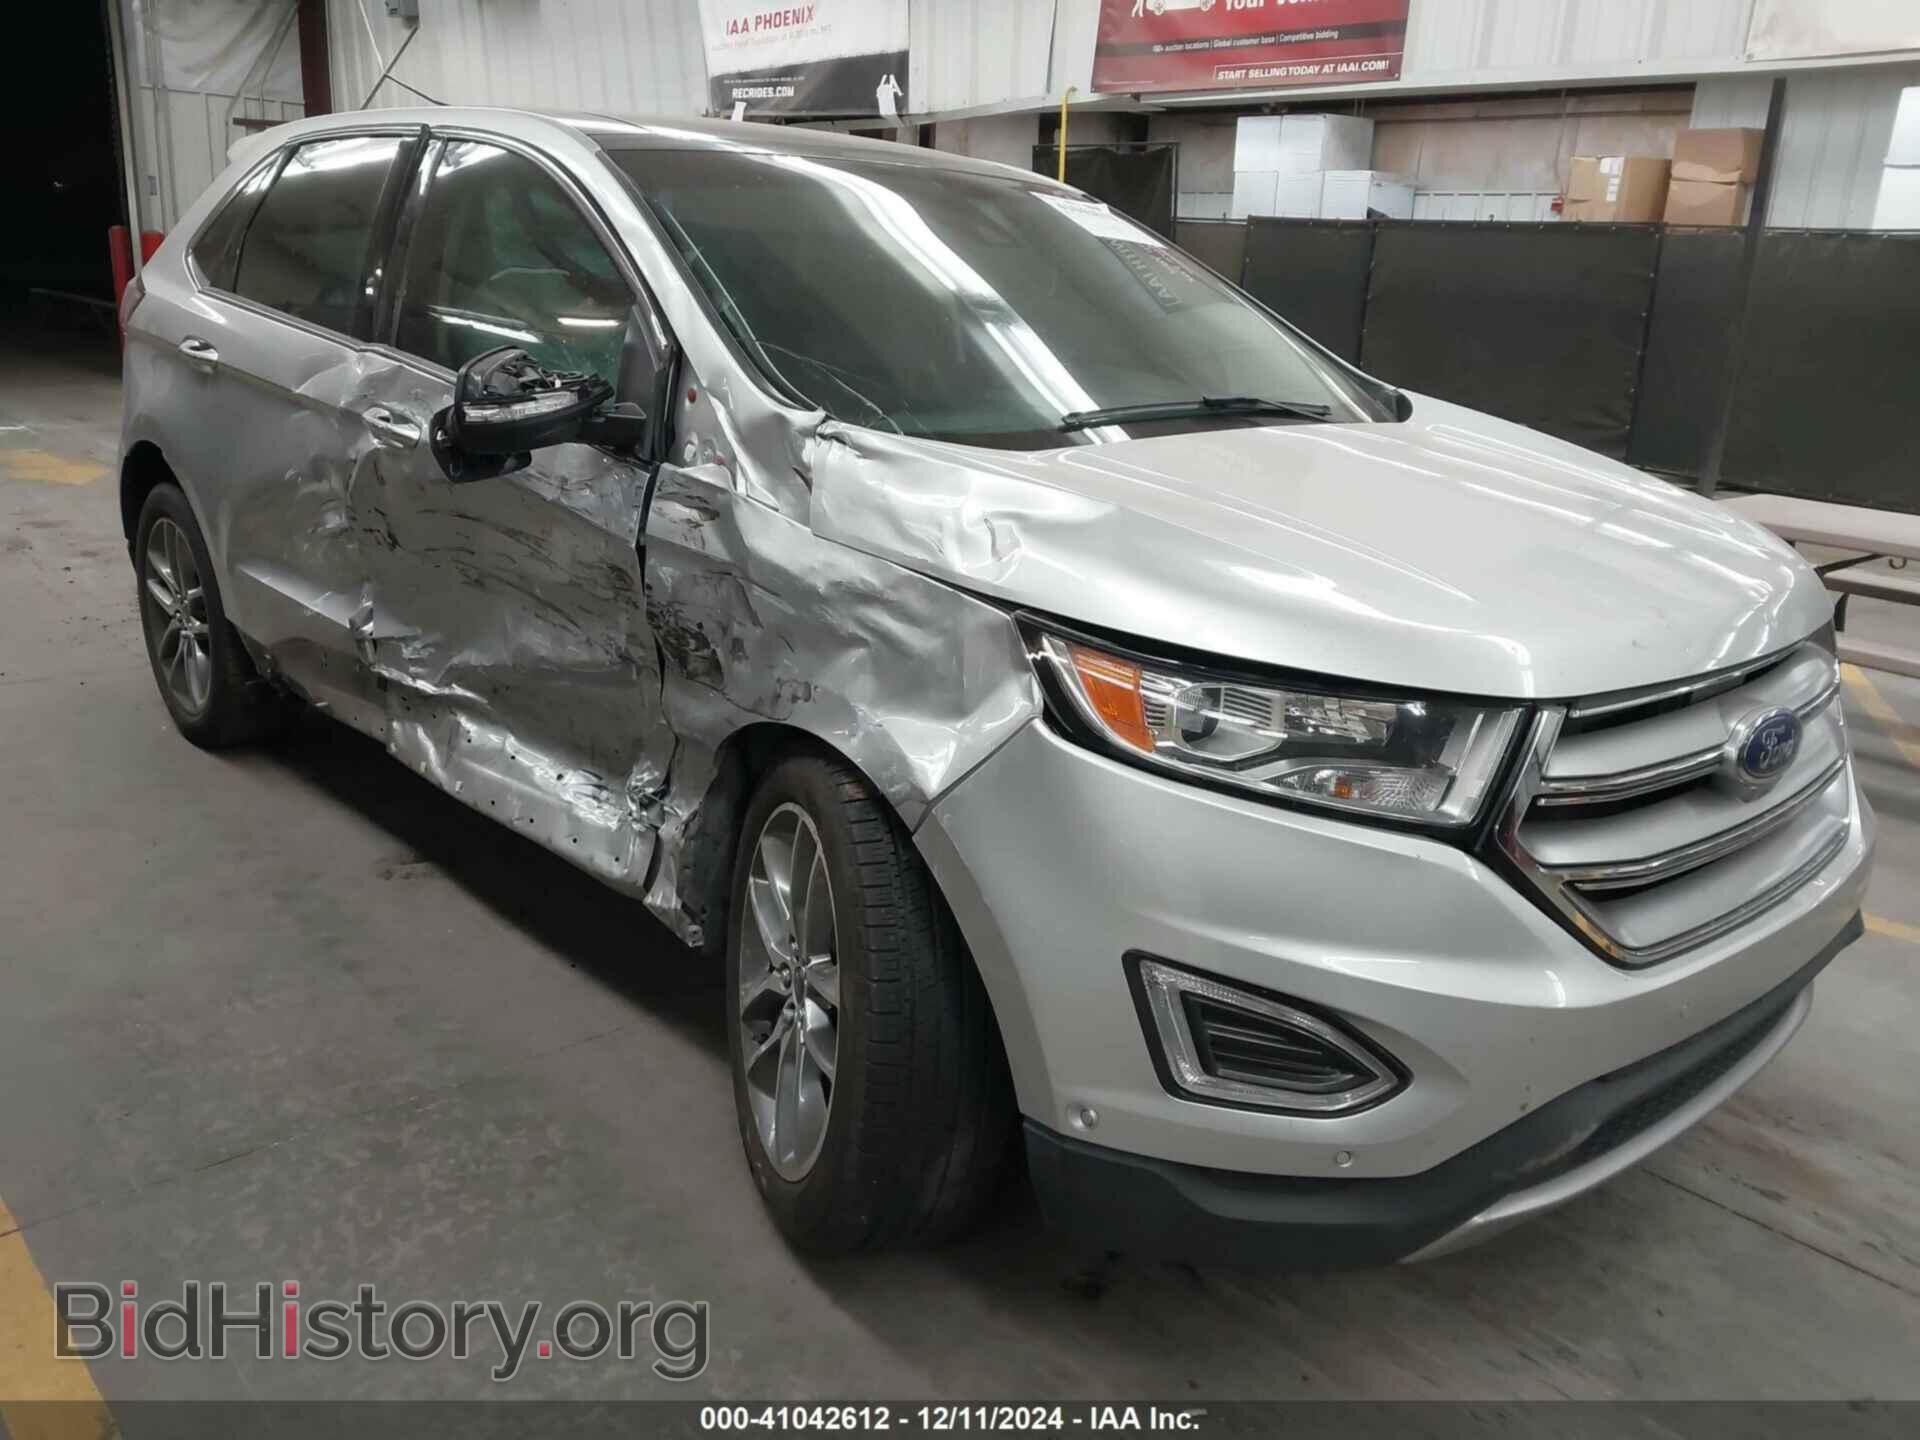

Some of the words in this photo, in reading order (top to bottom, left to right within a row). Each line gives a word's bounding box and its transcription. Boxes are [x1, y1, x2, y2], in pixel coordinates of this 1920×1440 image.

[726, 18, 749, 36] IAA
[754, 6, 814, 30] PHOENIX
[1217, 69, 1247, 81] START
[1248, 66, 1289, 79] SELLING
[1288, 65, 1320, 76] TODAY
[1321, 63, 1336, 74] AT
